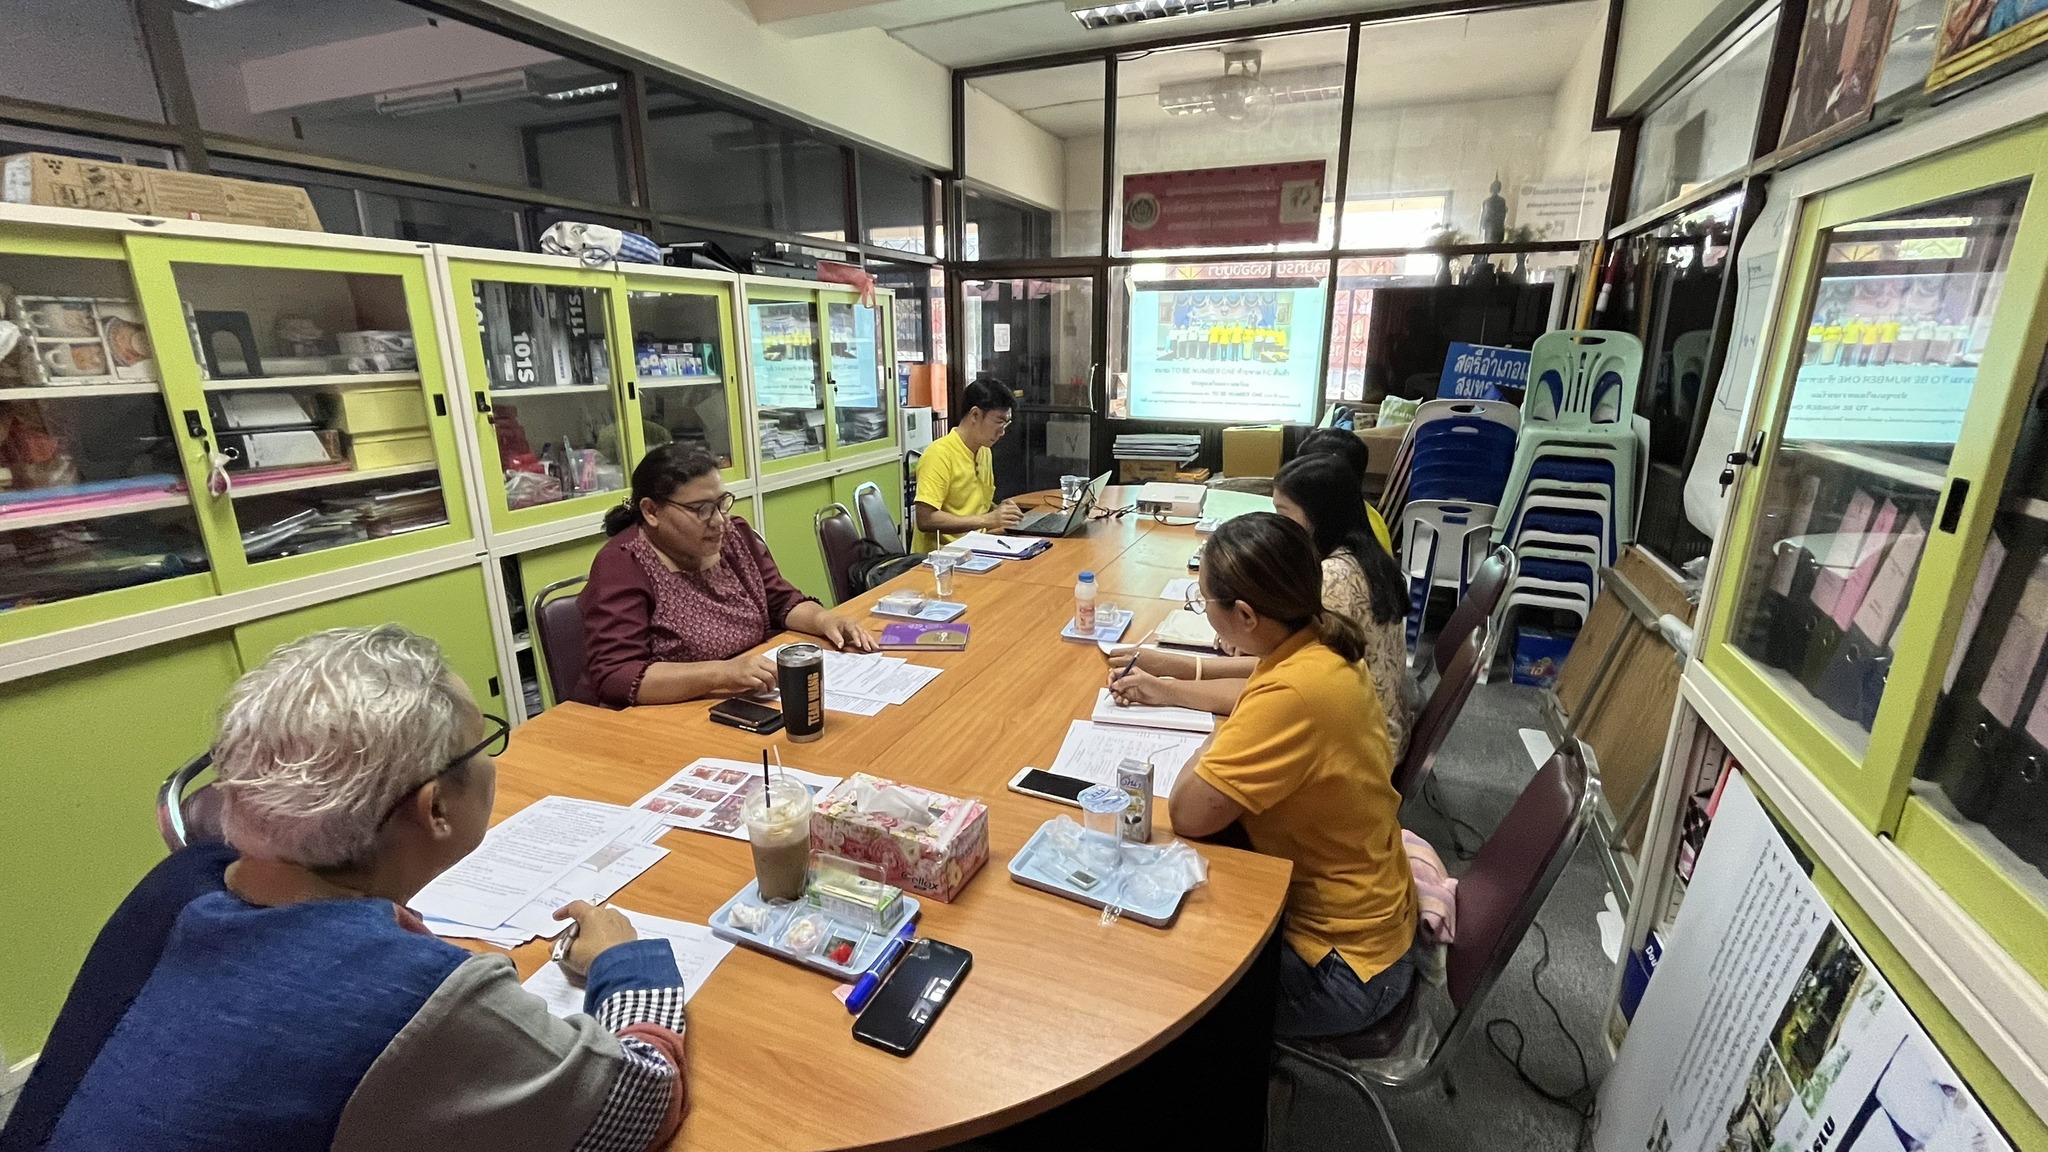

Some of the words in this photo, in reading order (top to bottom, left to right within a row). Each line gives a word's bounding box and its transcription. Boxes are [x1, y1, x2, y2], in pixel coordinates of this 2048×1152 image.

[568, 294, 585, 337] 111S
[513, 331, 535, 383] 101S
[1192, 367, 1220, 375] NUMBER
[1454, 348, 1529, 381] สตรีอำเภอเ
[808, 698, 820, 726] TEAM
